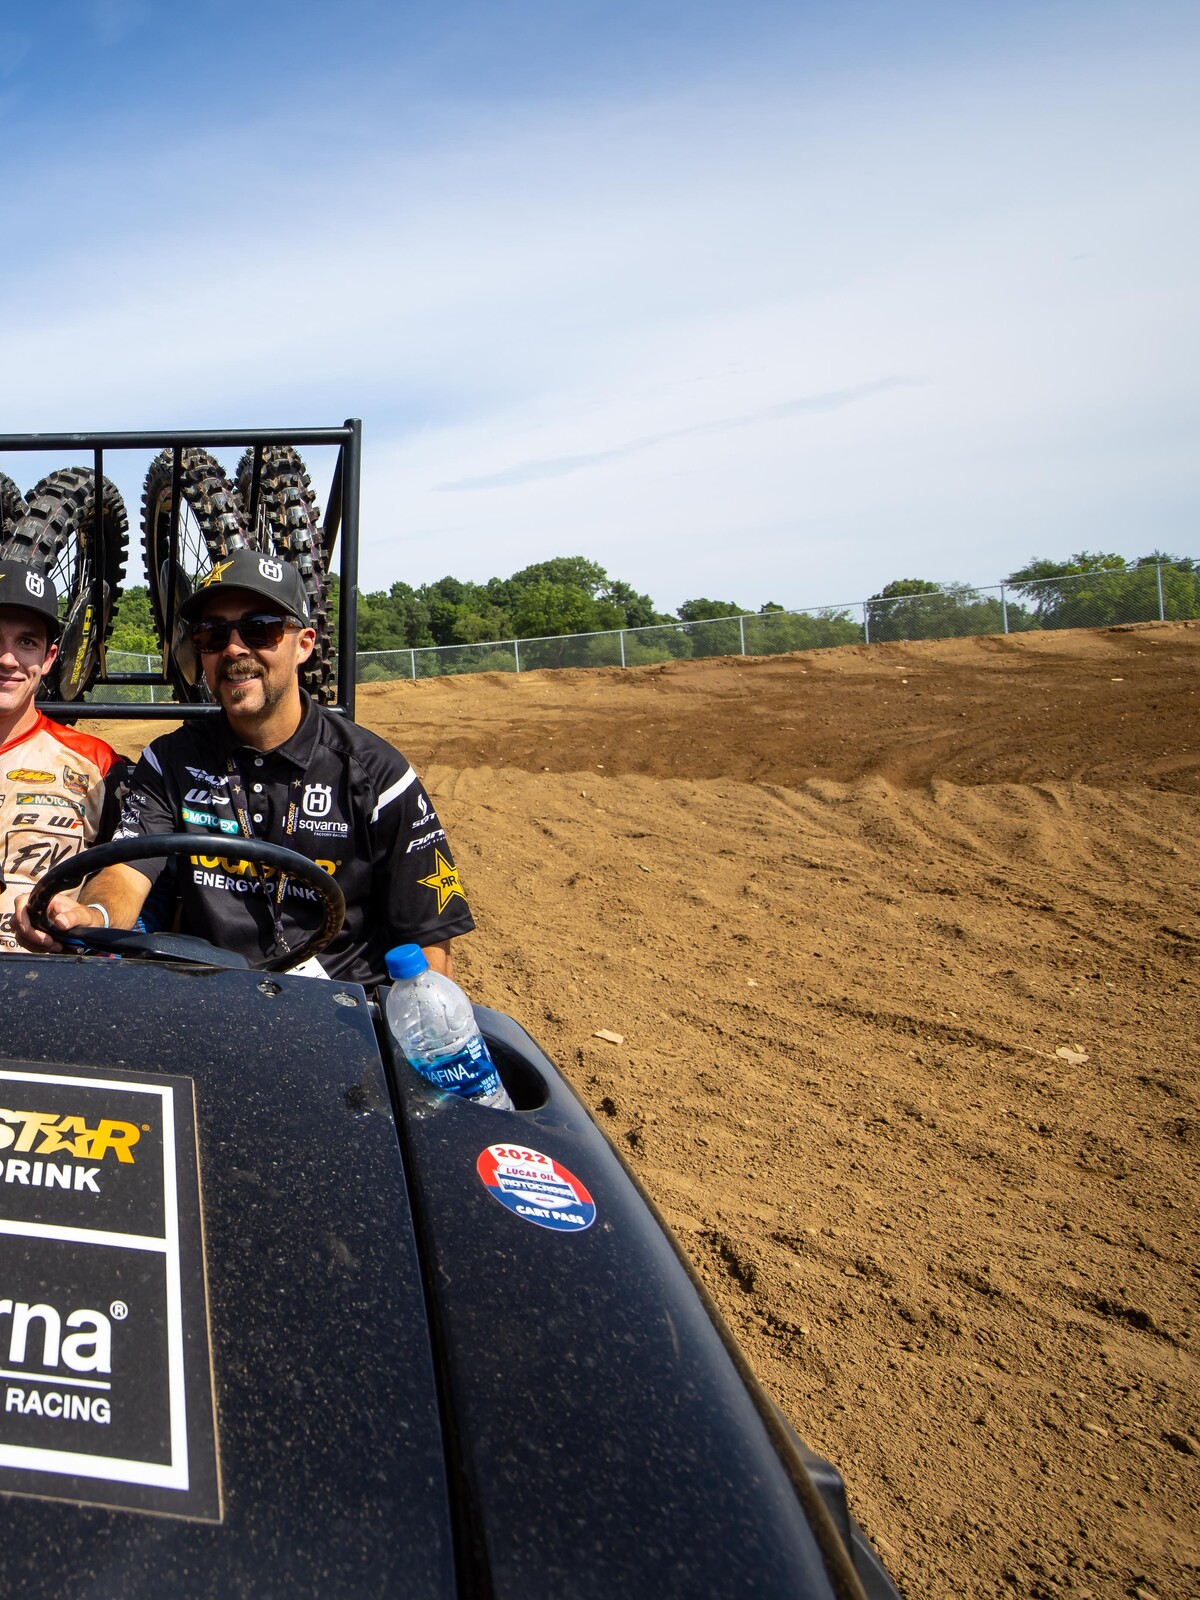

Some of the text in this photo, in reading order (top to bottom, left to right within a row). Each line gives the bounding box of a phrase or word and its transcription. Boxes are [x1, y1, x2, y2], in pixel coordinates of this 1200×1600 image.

[189, 812, 234, 832] MOTOEX
[194, 871, 261, 893] ENERGY
[495, 1147, 548, 1165] 2022
[506, 1167, 556, 1182] LUCAS OIL
[515, 1205, 585, 1225] CART PASS
[5, 1388, 111, 1424] RACING
